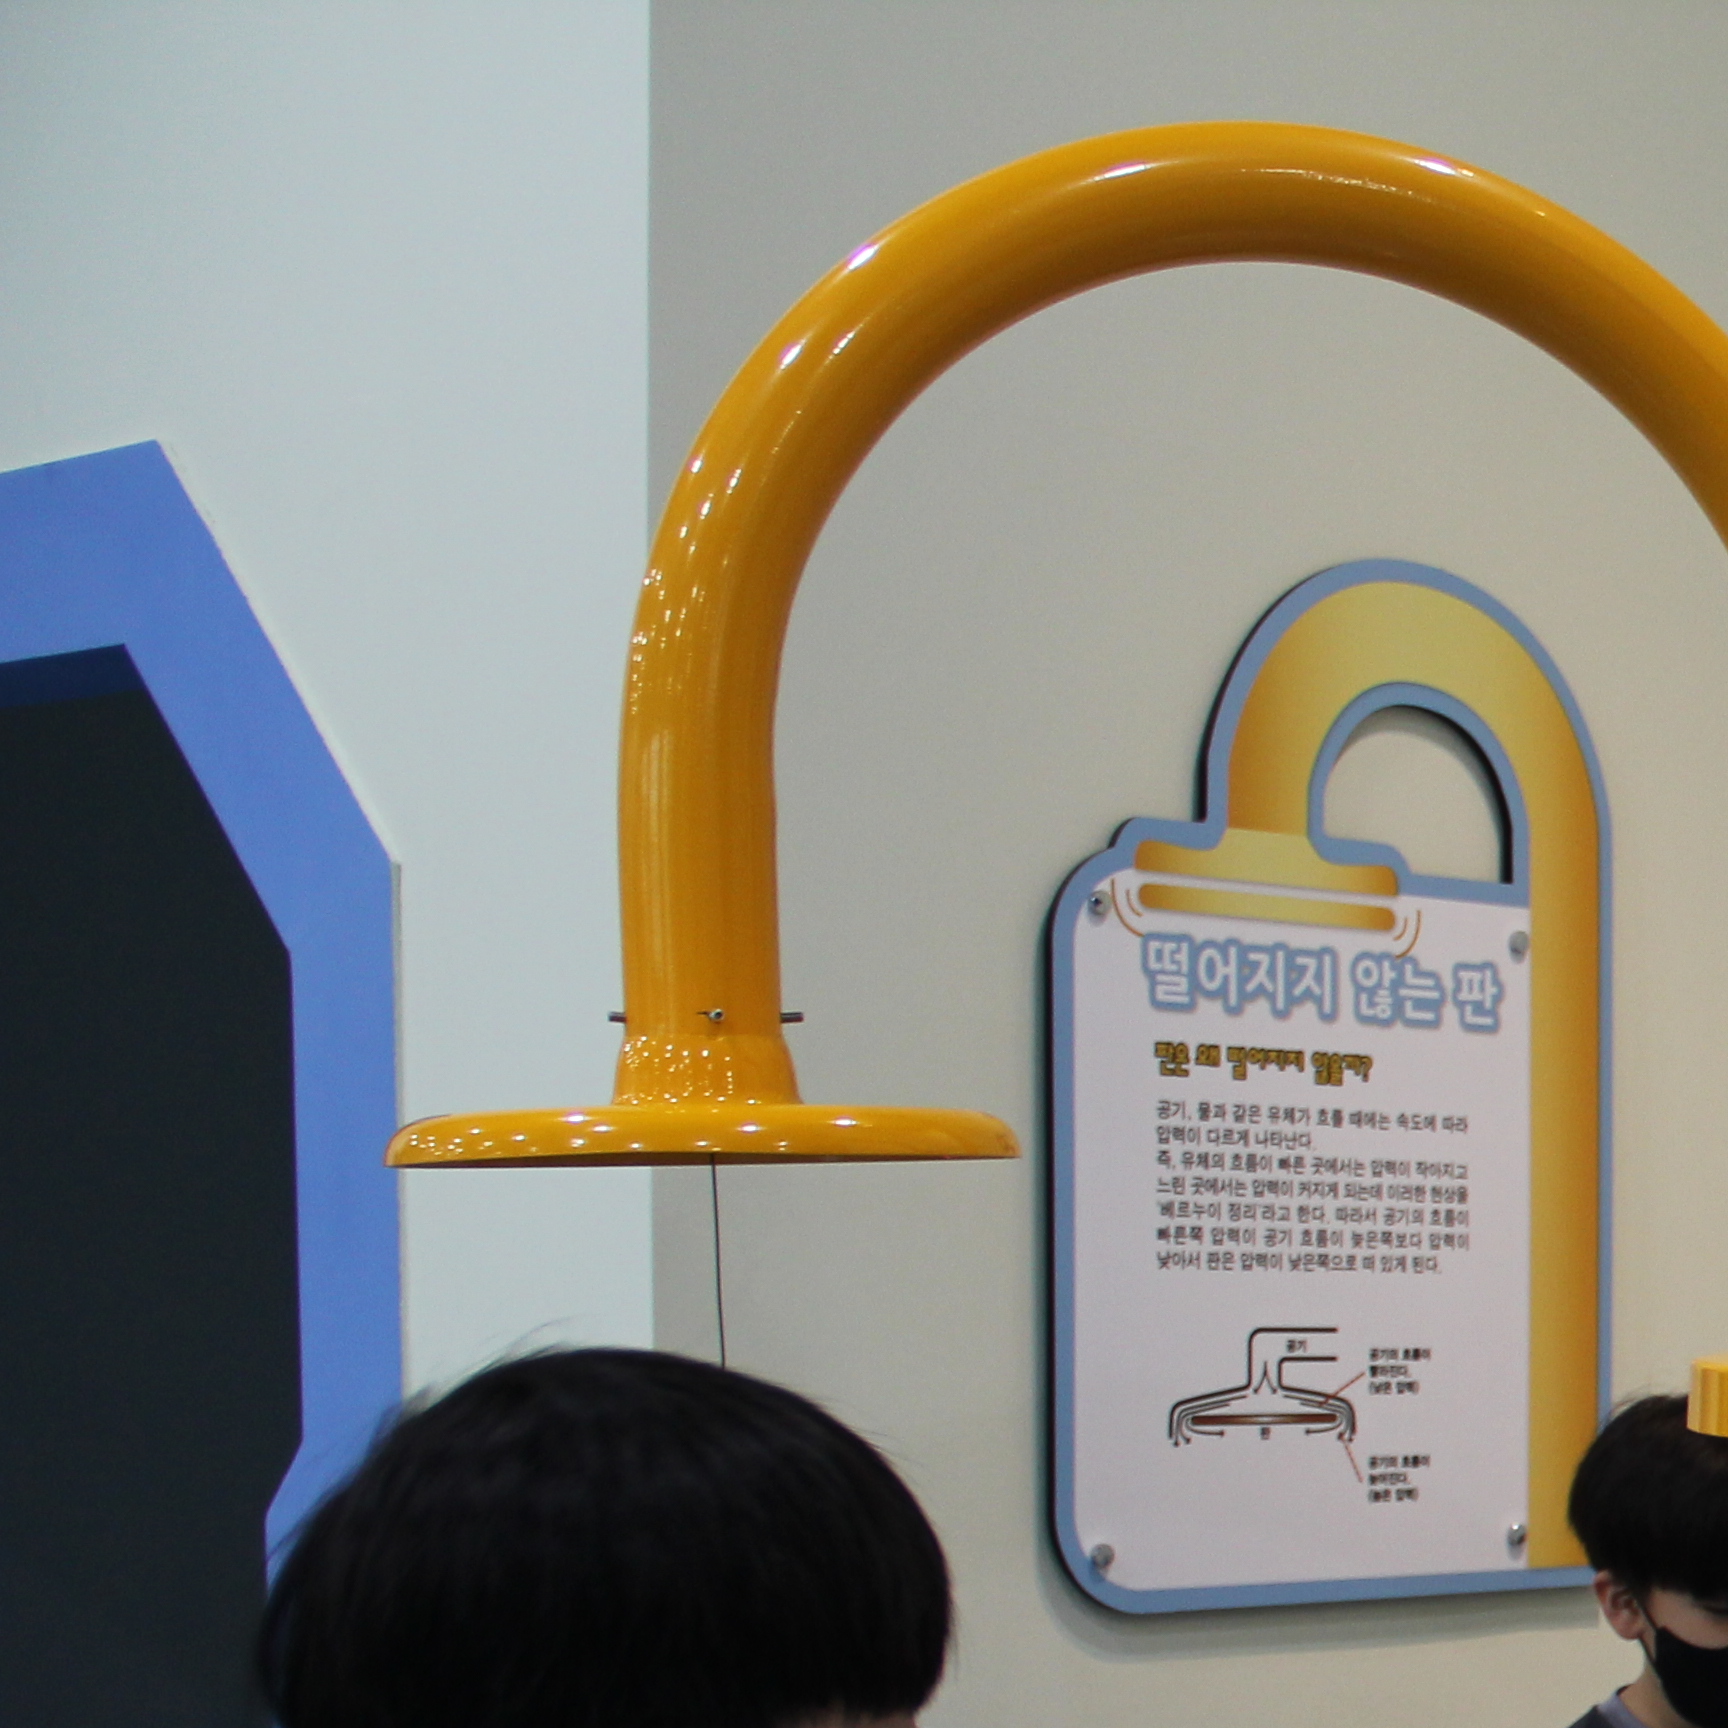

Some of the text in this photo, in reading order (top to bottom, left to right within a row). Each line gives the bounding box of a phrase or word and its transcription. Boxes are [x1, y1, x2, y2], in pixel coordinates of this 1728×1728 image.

[1146, 936, 1500, 1029] 떨어지지 않는 판
[1154, 1041, 1189, 1076] 판은
[1226, 1045, 1304, 1080] 떨어지지
